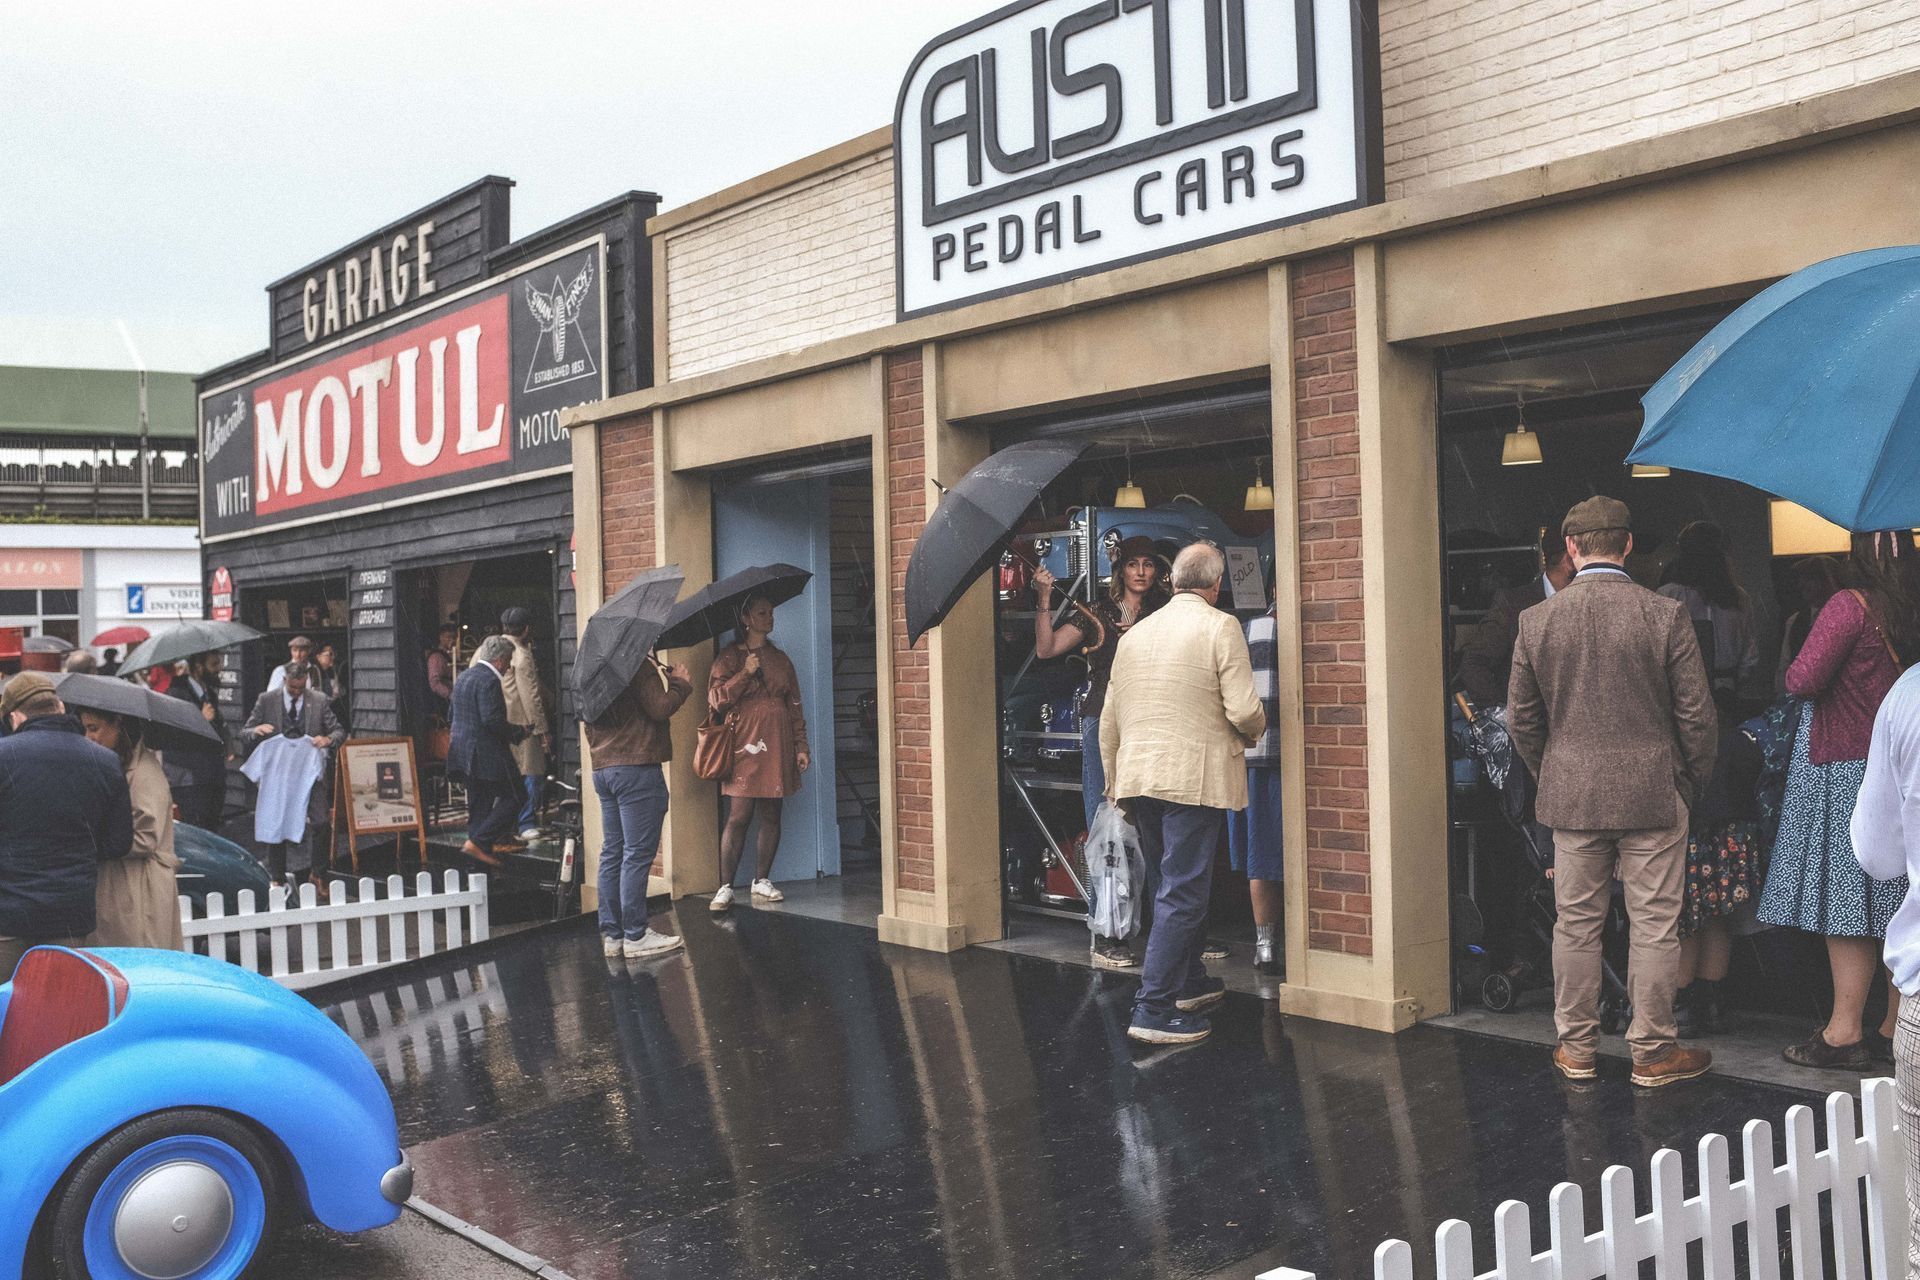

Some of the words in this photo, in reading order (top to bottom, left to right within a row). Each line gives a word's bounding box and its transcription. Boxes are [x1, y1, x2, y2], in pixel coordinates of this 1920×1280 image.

[921, 0, 1318, 227] AUSTIN
[931, 194, 1101, 281] PEDAL
[1133, 129, 1304, 225] CARS
[303, 220, 436, 342] GARAGE
[566, 270, 587, 316] FINCH
[534, 367, 569, 384] ESTABLISHED
[571, 360, 584, 374] 1853
[216, 475, 250, 518] WITH
[254, 324, 505, 503] MOTUL
[360, 570, 386, 584] OPENING
[363, 589, 384, 604] HOURS
[1233, 562, 1254, 585] SOLD
